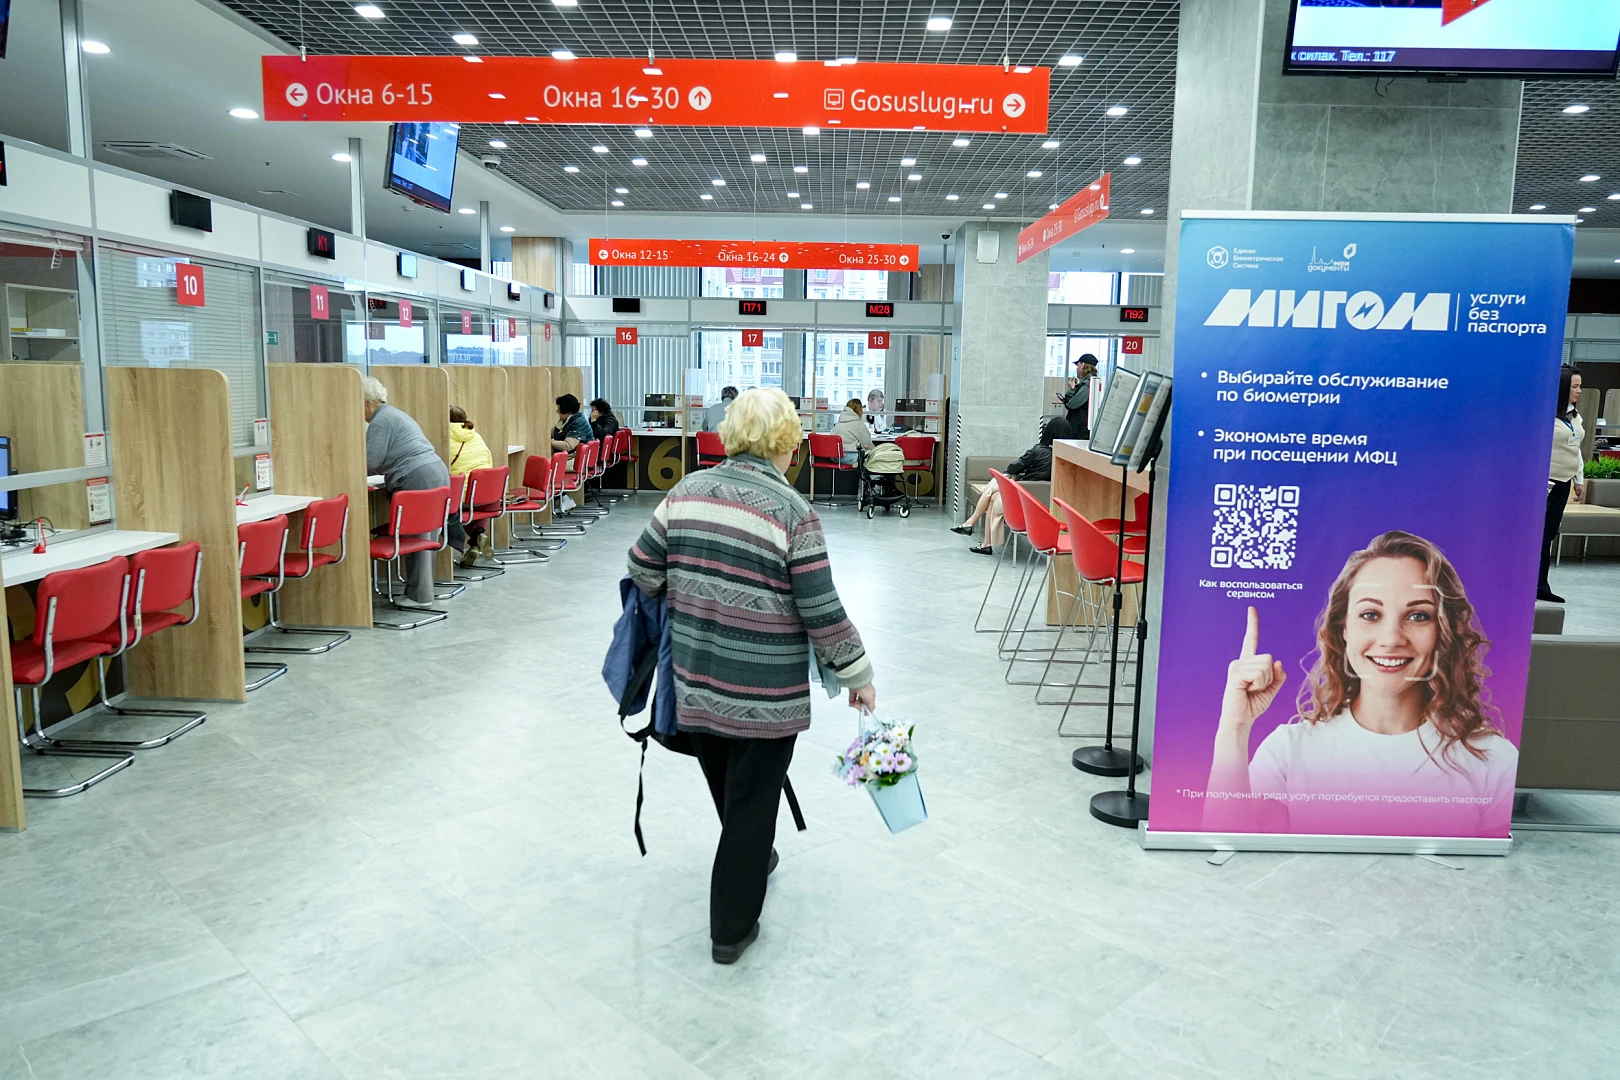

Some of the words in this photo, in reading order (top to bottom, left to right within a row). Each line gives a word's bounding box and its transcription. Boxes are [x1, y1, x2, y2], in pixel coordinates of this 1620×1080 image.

[1372, 50, 1396, 62] 117
[316, 83, 374, 105] Окна
[381, 83, 433, 105] 6-15
[543, 85, 602, 109] Окна
[611, 86, 680, 110] 16-30
[612, 250, 636, 260] Окна
[640, 250, 668, 260] 12-15
[718, 252, 743, 262] Окна
[746, 252, 776, 262] 16-24
[839, 254, 864, 264] Окна
[868, 254, 896, 264] 25-30
[184, 275, 198, 296] 10
[316, 294, 324, 311] 11
[1470, 292, 1526, 307] услуги
[402, 306, 409, 321] 12
[1203, 288, 1450, 332] МИГОМ
[1468, 306, 1500, 320] без
[464, 316, 470, 328] 13
[1467, 320, 1546, 336] паспорта
[622, 332, 632, 341] 16
[748, 334, 758, 342] 17
[872, 336, 884, 345] 18
[1126, 341, 1138, 350] 20
[1217, 370, 1314, 387] Выбирайте
[1318, 372, 1449, 390] обслуживание
[1216, 389, 1238, 403] по
[1243, 387, 1340, 406] биометрии
[1214, 428, 1308, 445] Экономьте
[1311, 432, 1368, 448] время
[1213, 448, 1246, 463] при
[1250, 448, 1348, 465] посещении
[1353, 450, 1398, 466] МФЦ
[1199, 578, 1217, 589] Как
[1220, 580, 1303, 591] воспользоваться
[1226, 590, 1276, 600] сервисом
[1182, 789, 1204, 799] При
[1206, 790, 1262, 802] получении
[1264, 791, 1288, 801] ряда
[1289, 792, 1316, 802] услуг
[1318, 792, 1380, 803] потребуется
[1382, 794, 1450, 804] предоставить
[1452, 796, 1494, 805] паспорт
